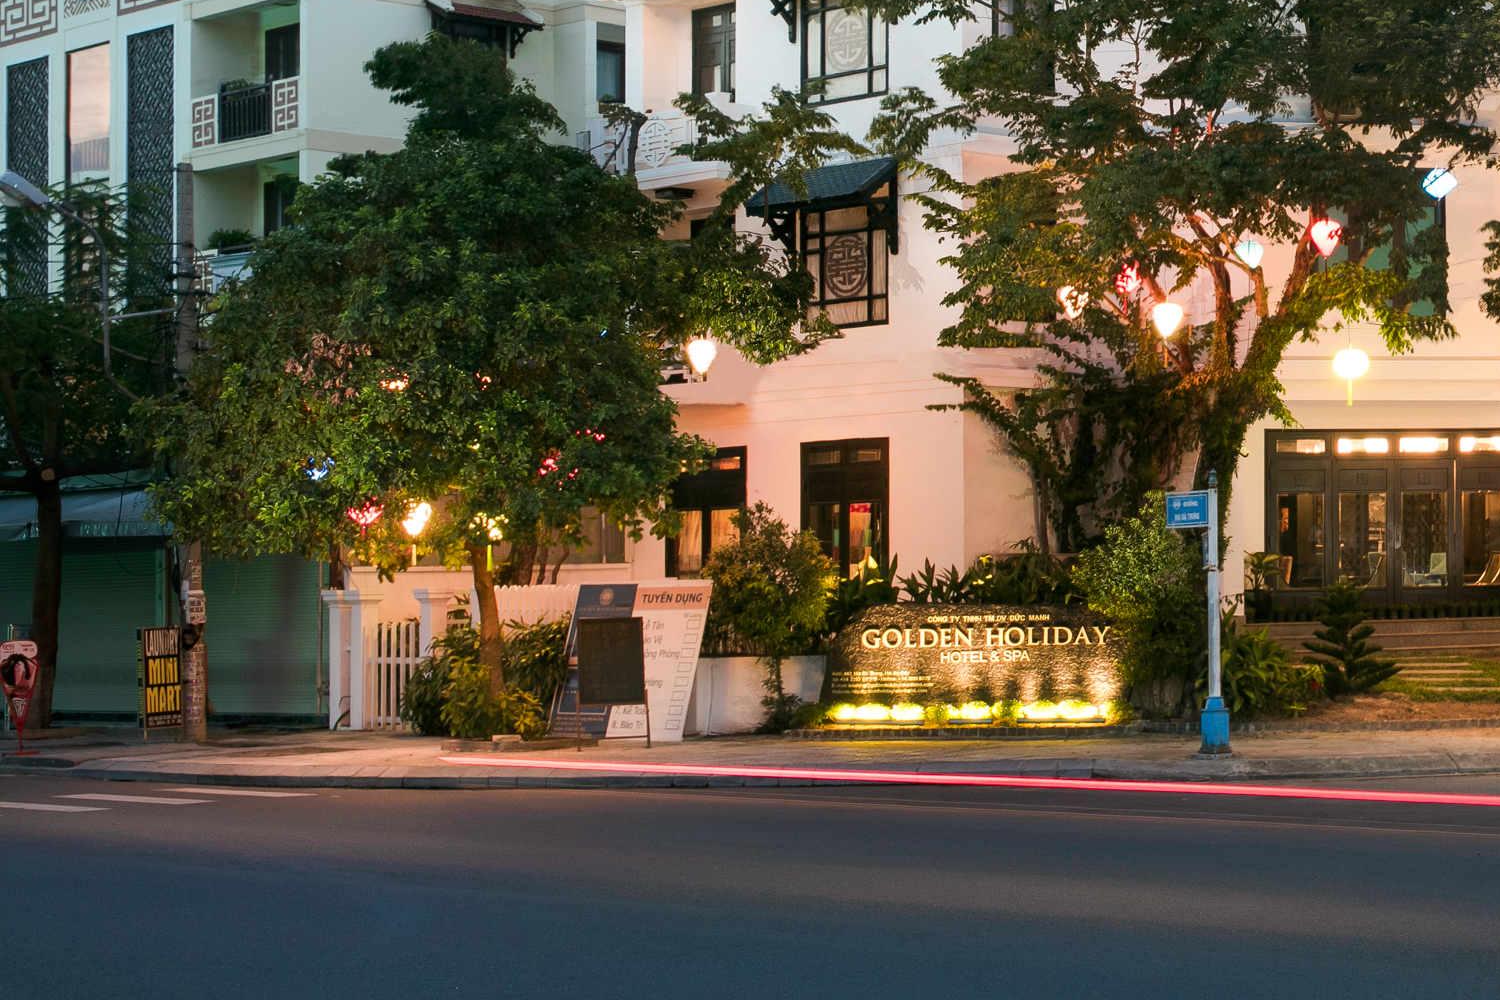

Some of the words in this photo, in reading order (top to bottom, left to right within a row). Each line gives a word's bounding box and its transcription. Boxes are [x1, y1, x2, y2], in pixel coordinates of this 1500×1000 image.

[675, 593, 703, 605] DỤNG
[927, 615, 948, 623] CÔNG
[1009, 613, 1026, 621] ĐỨC
[145, 628, 179, 656] LAUNDRY
[861, 627, 974, 649] GOLDEN
[985, 626, 1111, 648] HOLIDAY
[940, 651, 988, 664] HOTEL
[990, 650, 1000, 662] &
[1003, 649, 1030, 662] SPA
[148, 657, 178, 685] MINI
[146, 685, 181, 713] MART
